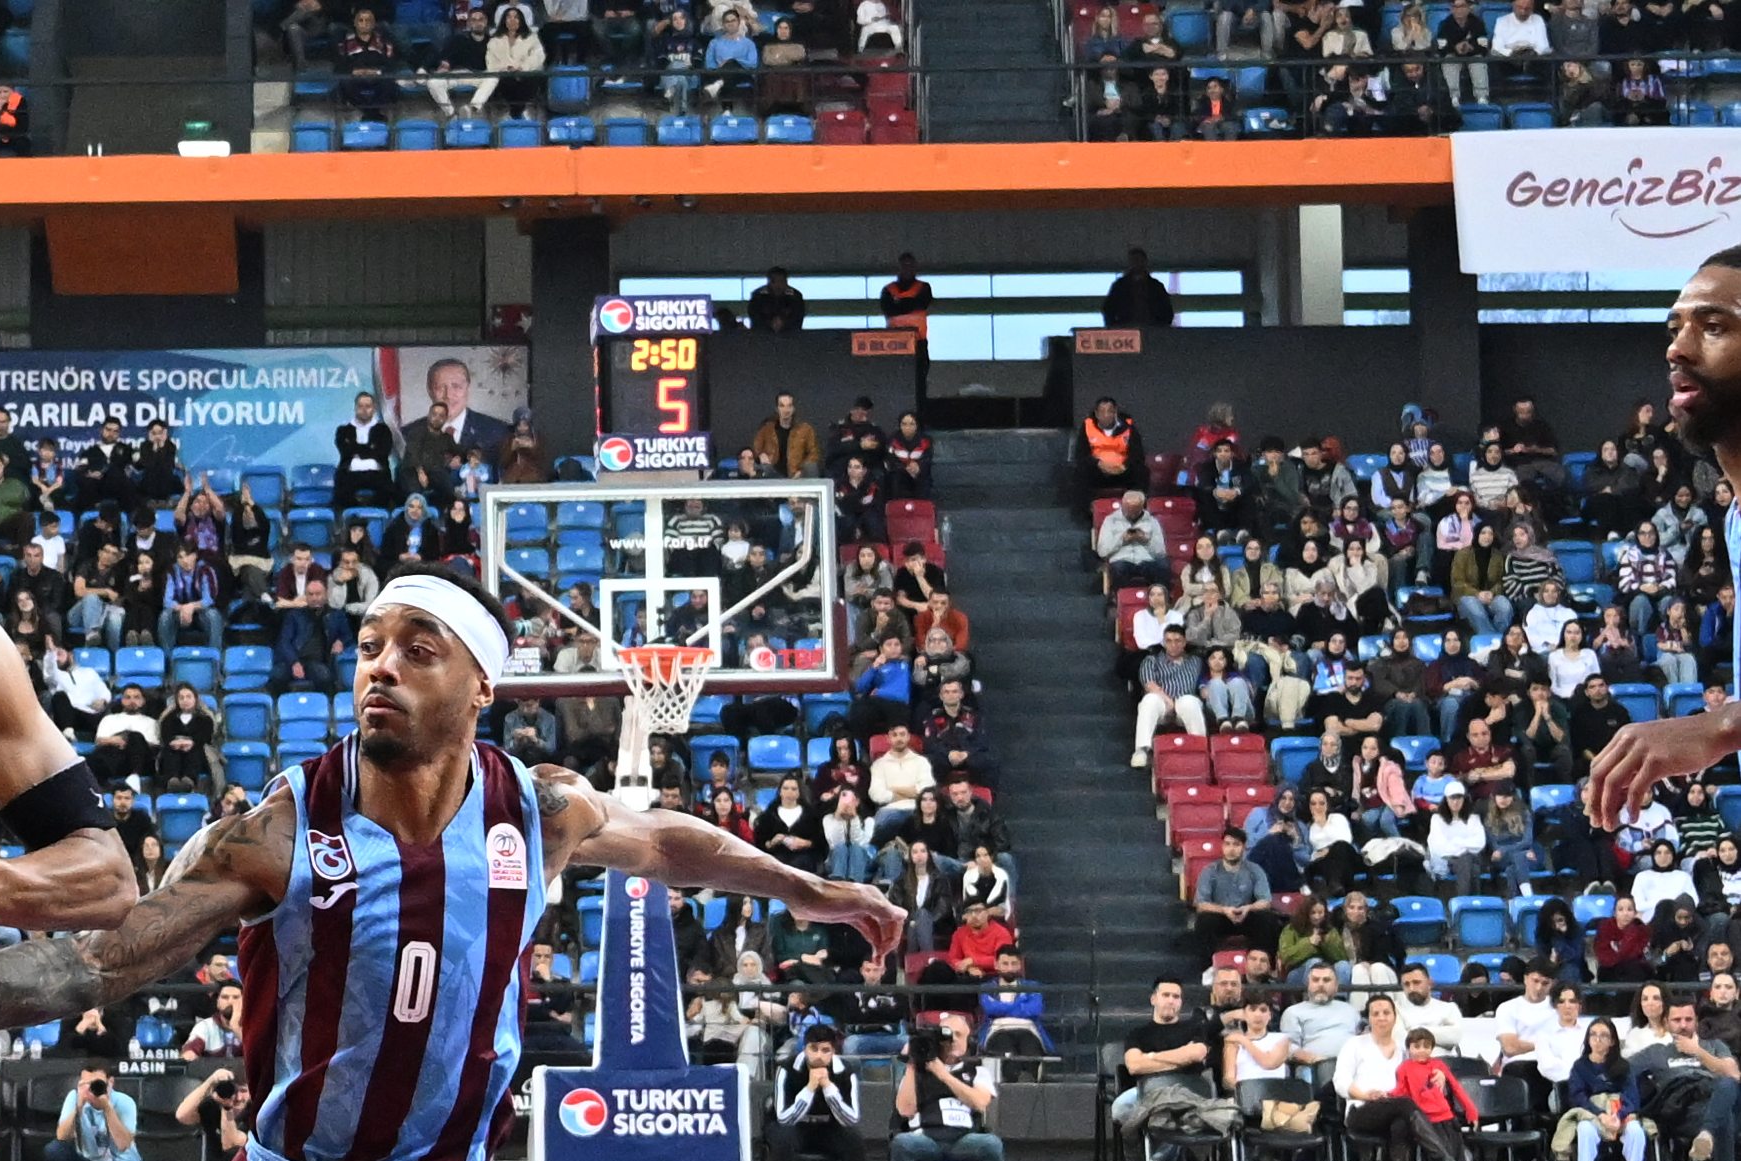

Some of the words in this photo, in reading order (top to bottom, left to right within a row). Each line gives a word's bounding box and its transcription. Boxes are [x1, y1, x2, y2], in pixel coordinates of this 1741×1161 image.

[631, 338, 697, 371] 2:50
[100, 370, 131, 392] VE
[136, 367, 359, 393] SPORCULARIMIZA
[657, 377, 689, 434] 5
[393, 941, 437, 1023] 0
[119, 1061, 165, 1074] BASIN
